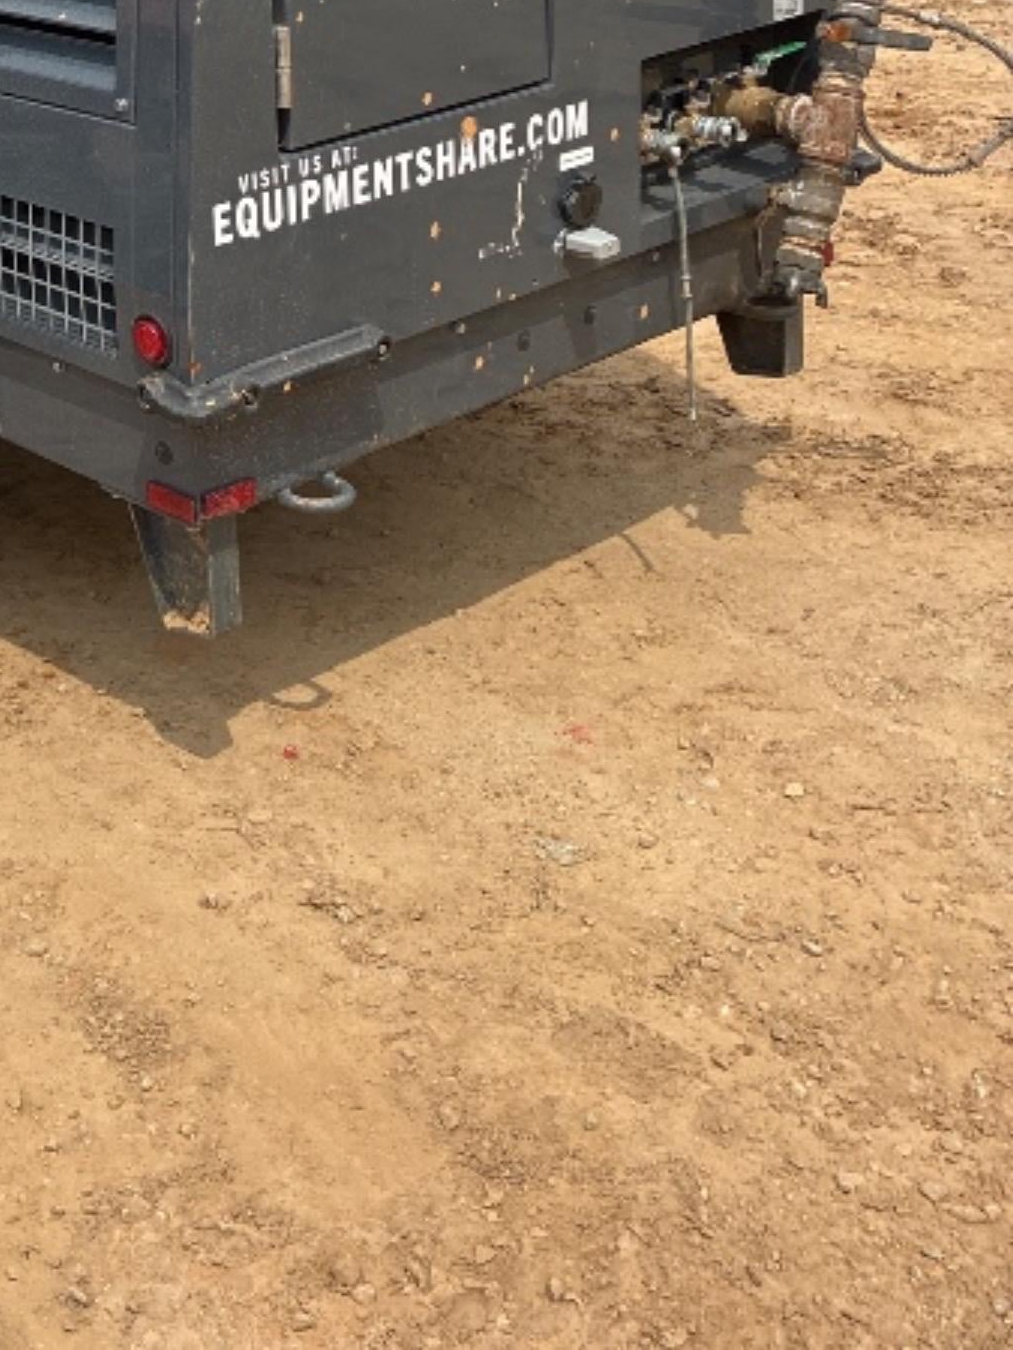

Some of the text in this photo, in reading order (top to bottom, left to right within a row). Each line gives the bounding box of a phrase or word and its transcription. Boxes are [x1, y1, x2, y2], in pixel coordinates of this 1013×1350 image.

[211, 98, 589, 247] EQUIPMENTSHARE.COM
[237, 162, 290, 195] VISIT
[298, 154, 322, 179] US
